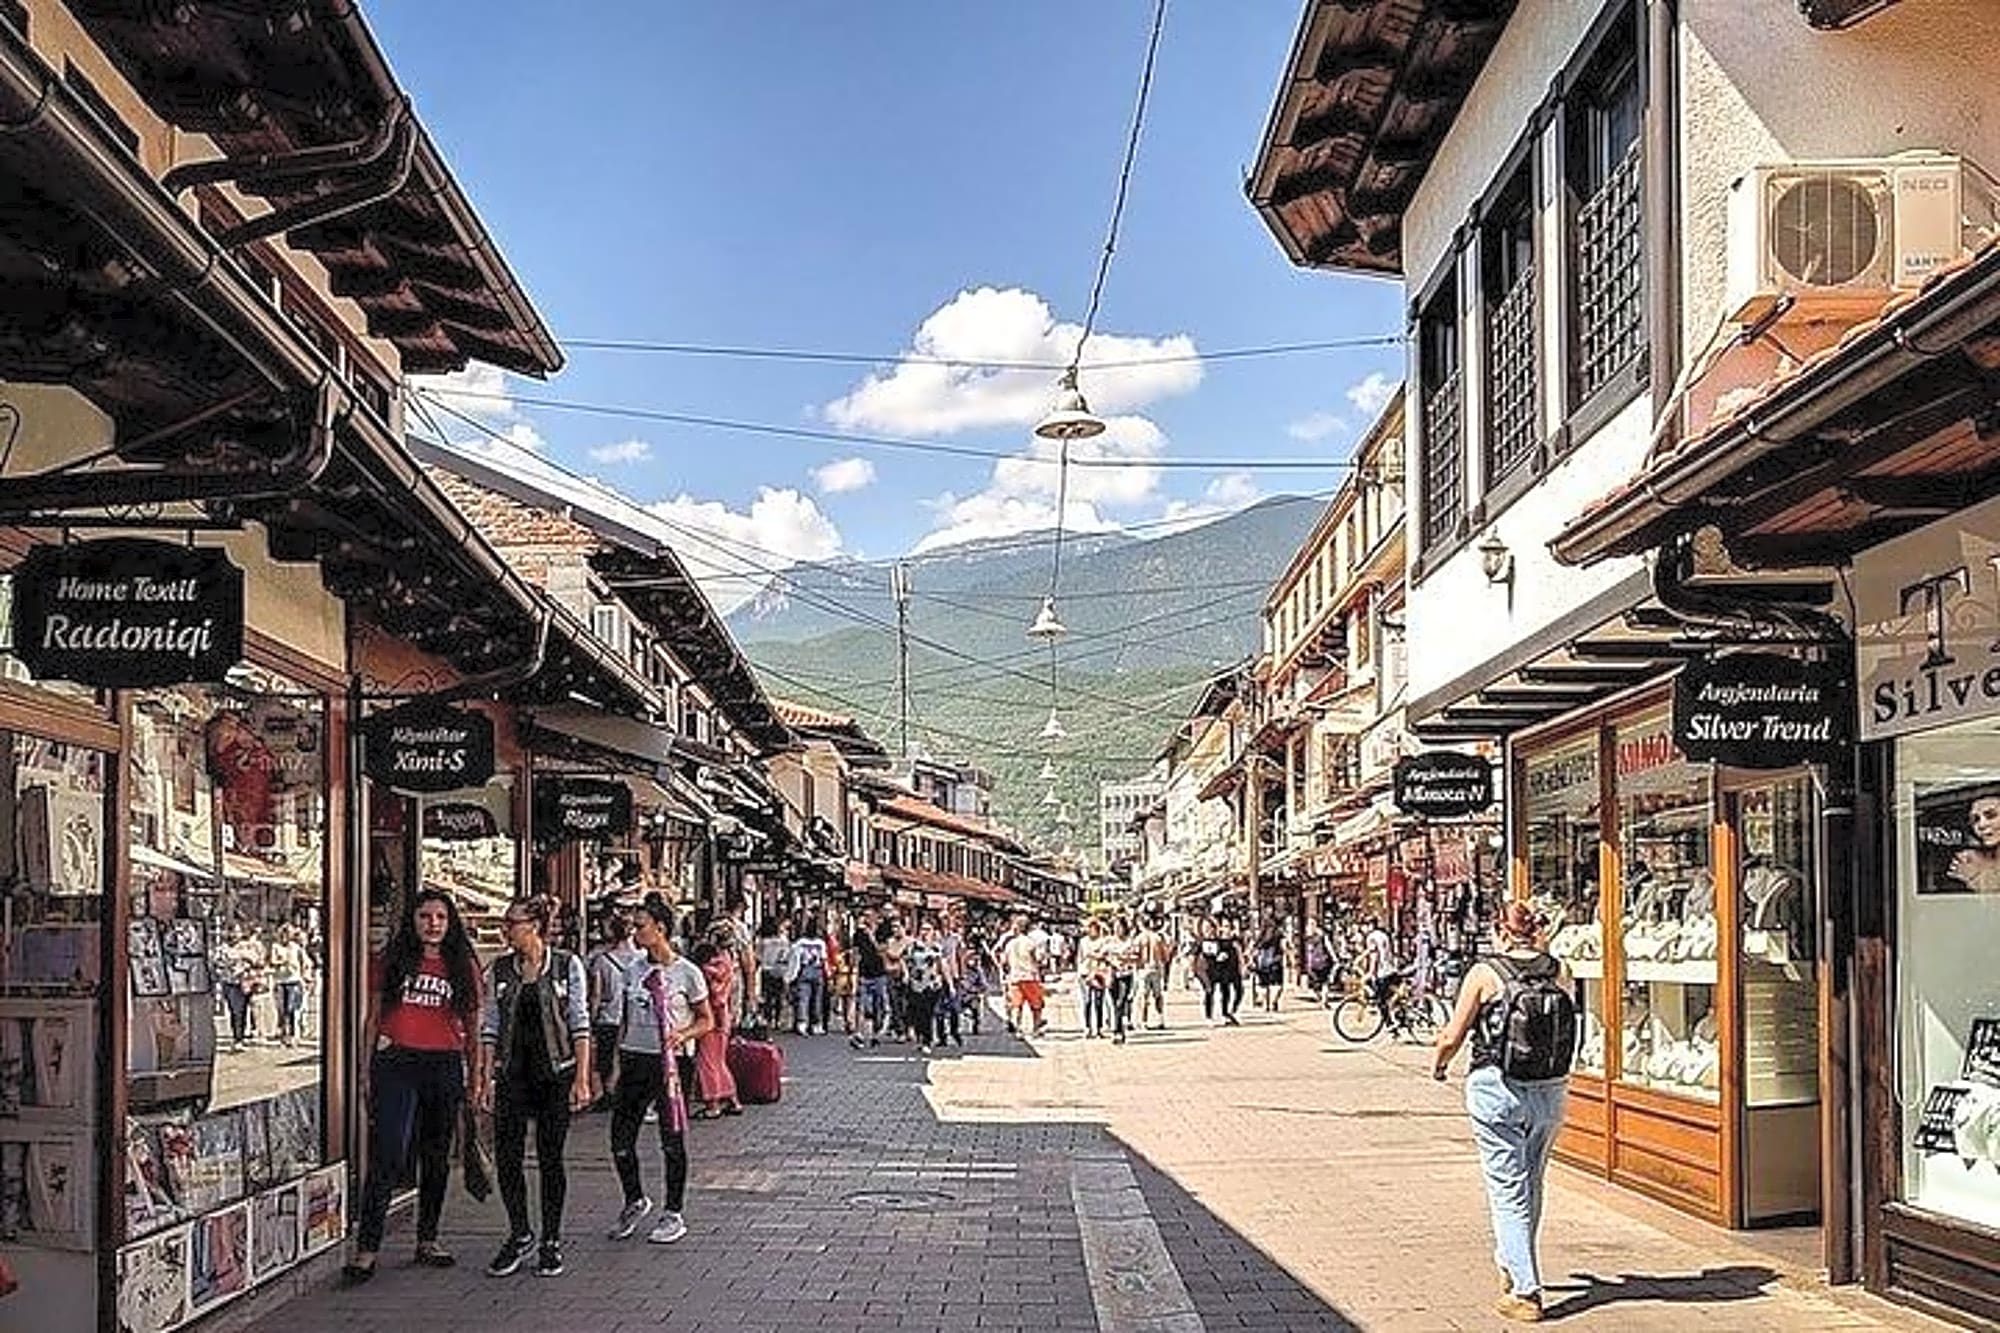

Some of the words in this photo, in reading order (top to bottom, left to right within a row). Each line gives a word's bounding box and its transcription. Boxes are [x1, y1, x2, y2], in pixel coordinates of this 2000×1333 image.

[57, 576, 128, 600] Home
[133, 576, 198, 601] Textil
[42, 613, 212, 659] Radoniqi
[1698, 681, 1820, 706] Argjendaria
[1685, 712, 1759, 741] Silver
[1760, 715, 1831, 741] Trend
